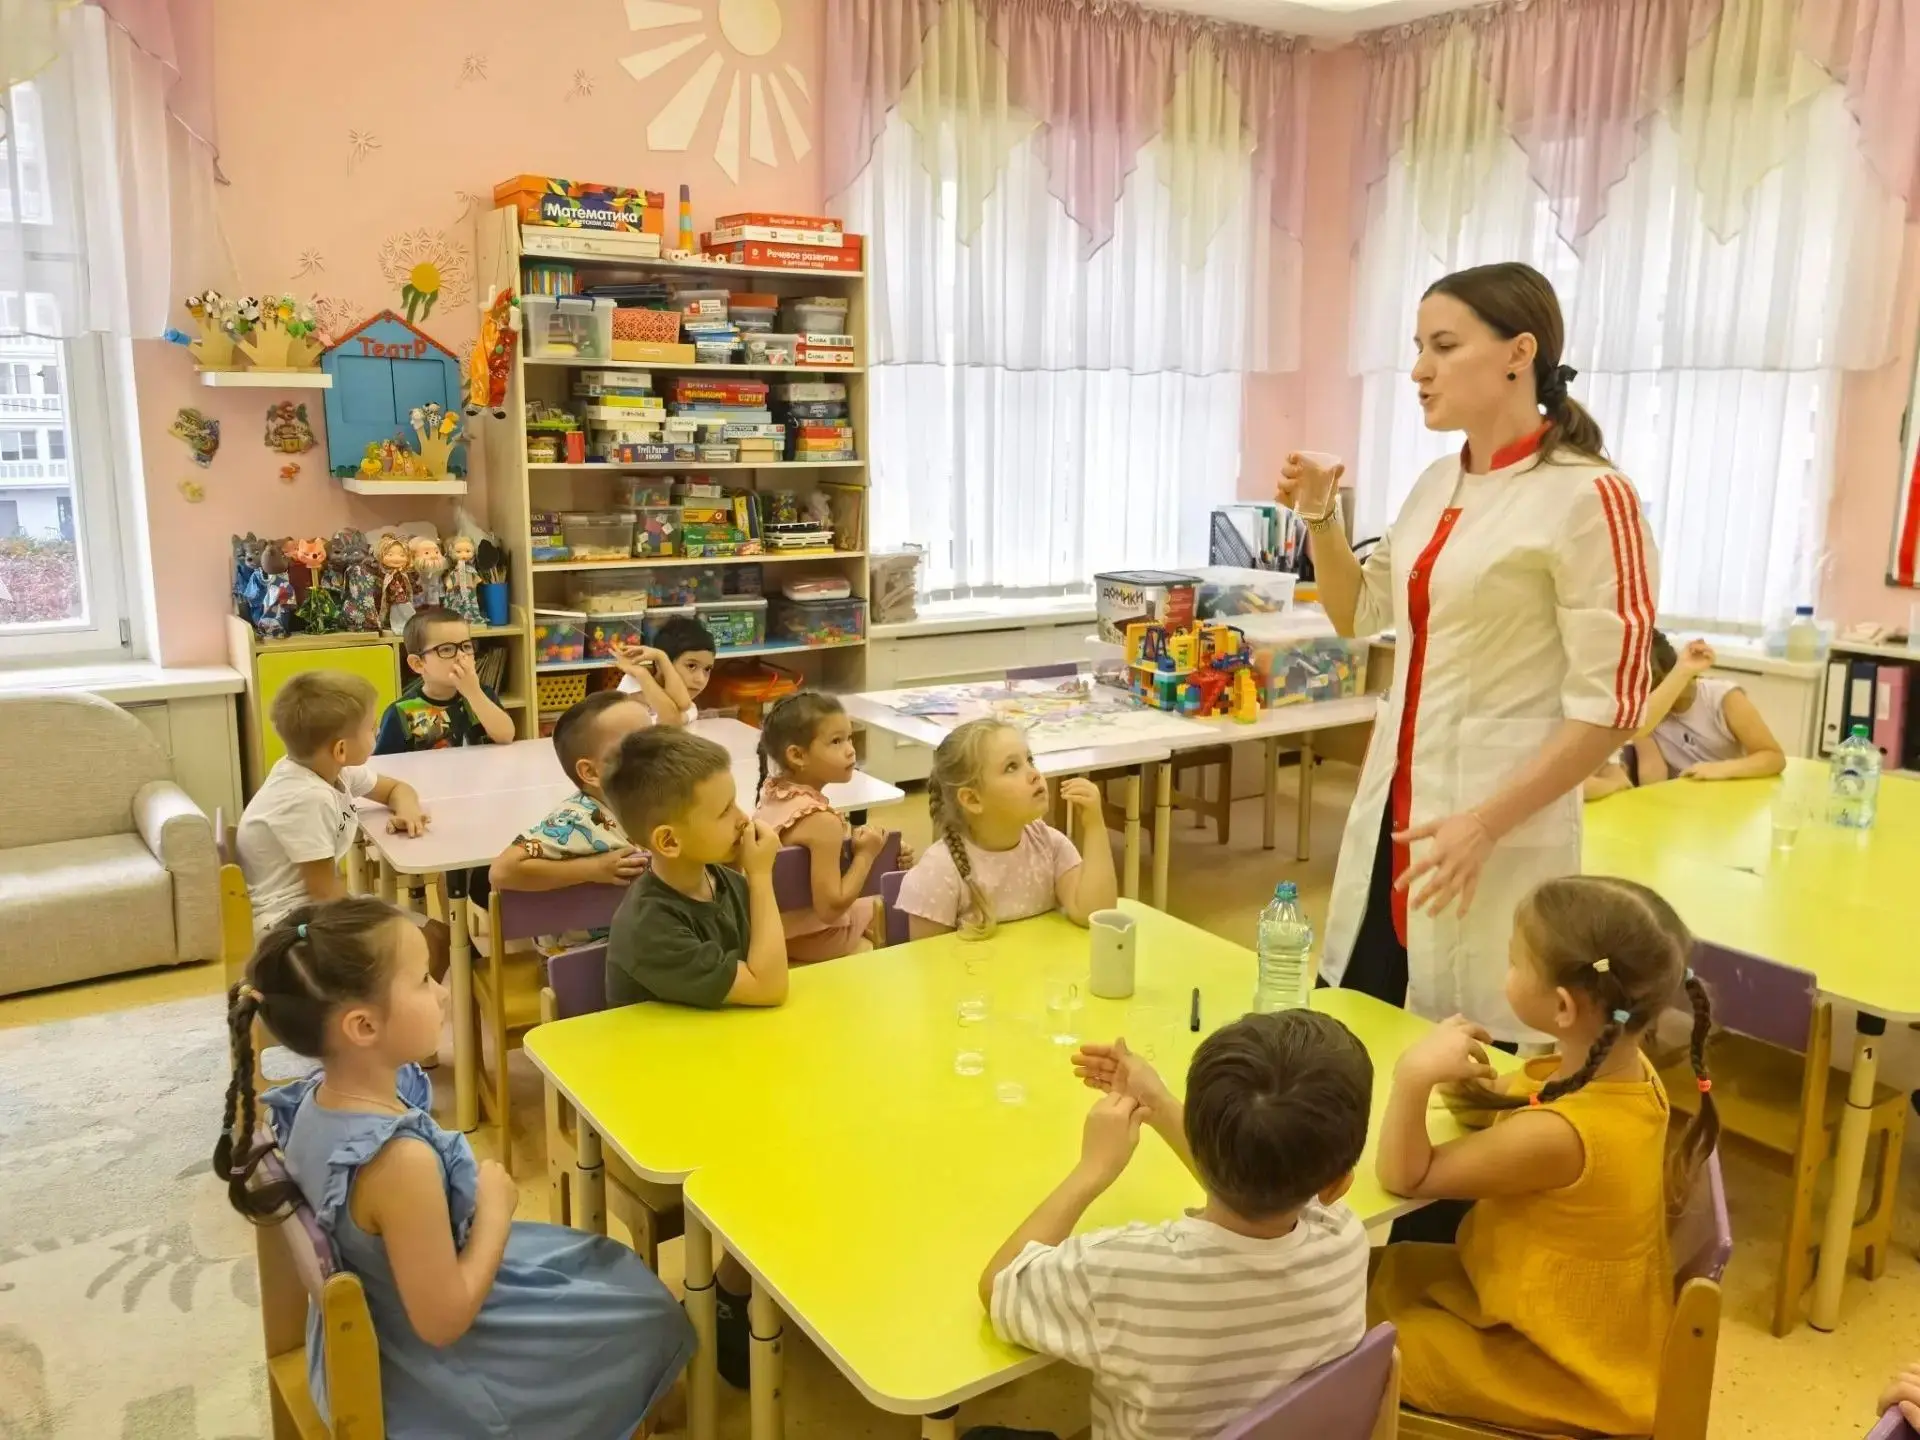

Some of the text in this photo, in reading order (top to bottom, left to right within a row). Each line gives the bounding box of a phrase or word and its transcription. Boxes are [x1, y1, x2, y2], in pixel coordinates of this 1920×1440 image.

[546, 202, 638, 223] Математика
[766, 249, 839, 263] Речевое развитие
[1863, 1047, 1873, 1060] 1
